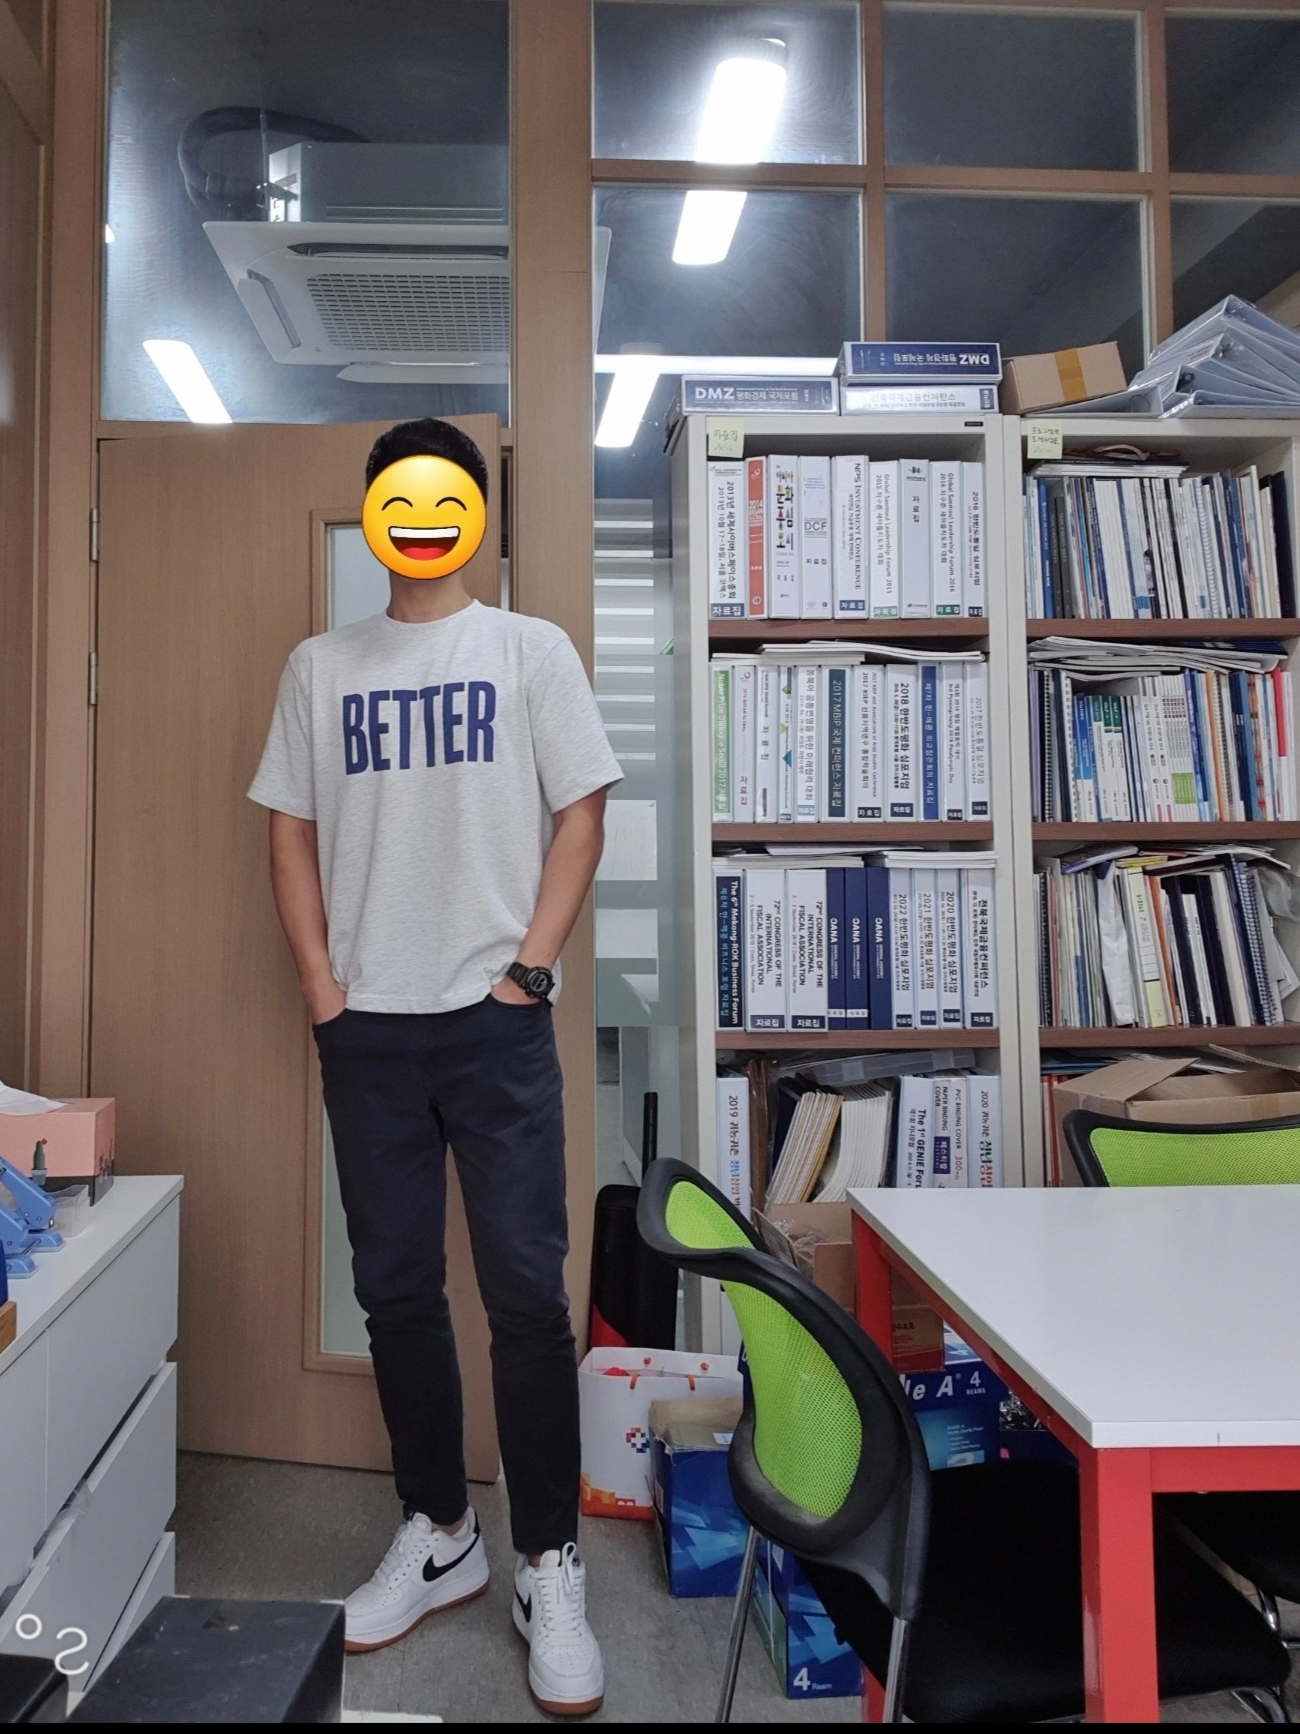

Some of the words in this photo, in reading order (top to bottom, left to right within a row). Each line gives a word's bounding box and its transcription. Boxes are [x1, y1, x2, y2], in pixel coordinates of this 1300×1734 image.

[958, 354, 990, 365] DMZ
[695, 387, 735, 399] DMZ
[736, 390, 766, 400] 평화경제
[769, 390, 798, 400] 국제포럼
[718, 487, 726, 511] 2013년
[727, 481, 735, 509] 2013년
[718, 513, 726, 528] 10월
[804, 521, 827, 530] DCF
[727, 511, 736, 599] 세계사이버스페이스총회
[877, 553, 883, 565] 대회
[940, 551, 947, 564] 대회
[719, 563, 727, 576] 서울
[719, 578, 727, 599] 코엑스
[713, 605, 742, 616] 자료집
[806, 669, 815, 692] 동북아
[833, 680, 841, 701] 2017
[718, 696, 726, 714] Prize
[900, 682, 909, 705] 2018
[806, 694, 815, 732] 공동번영을
[833, 704, 841, 725] MBIP
[343, 681, 496, 775] BETTER
[717, 715, 727, 747] Dialogue
[832, 728, 841, 744] 국제
[900, 708, 910, 752] 한반도평화
[805, 735, 815, 750] 위한
[718, 748, 727, 768] Seoul
[805, 752, 815, 783] 미래협력
[832, 747, 841, 779] 컨퍼런스
[925, 735, 933, 778] 외교장관회의
[719, 769, 727, 788] 2017
[900, 754, 910, 789] 심포지엄
[805, 785, 815, 801] 대화
[832, 781, 841, 807] 자료집
[731, 881, 739, 895] The
[731, 896, 739, 907] 6th
[899, 894, 907, 915] 2022
[946, 891, 954, 914] 2020
[721, 911, 729, 939] 한-메콩
[756, 904, 764, 932] FISCAL
[729, 908, 739, 961] Mekong-ROK
[830, 918, 838, 943] OANA
[852, 918, 860, 943] OANA
[875, 918, 883, 943] OANA
[900, 918, 909, 957] 한반도평화
[924, 917, 933, 955] 한반도평화
[947, 916, 956, 957] 한반도평화
[978, 899, 989, 989] 전북국제금융컨퍼런스
[721, 943, 729, 972] 비즈니스
[774, 960, 781, 971] OF
[817, 960, 823, 971] OF
[720, 975, 729, 991] 포럼
[731, 962, 739, 996] Business
[901, 960, 910, 991] 심포지엄
[925, 958, 934, 989] 심포지엄
[948, 960, 957, 993] 심포지엄
[720, 994, 729, 1016] 자료집
[731, 998, 739, 1024] Forum
[756, 1018, 779, 1027] 자료집
[797, 1018, 820, 1027] 자료집
[729, 1095, 738, 1117] 2019
[981, 1090, 989, 1108] 2020
[917, 1109, 926, 1126] The
[981, 1111, 989, 1137] 귀농귀촌
[729, 1121, 738, 1156] 귀농귀촌
[917, 1127, 926, 1137] 1st
[916, 1139, 926, 1167] GENIE
[955, 1155, 963, 1170] 300
[970, 1370, 981, 1388] 4
[793, 1667, 811, 1691] 4
[812, 1682, 832, 1691] Ream
